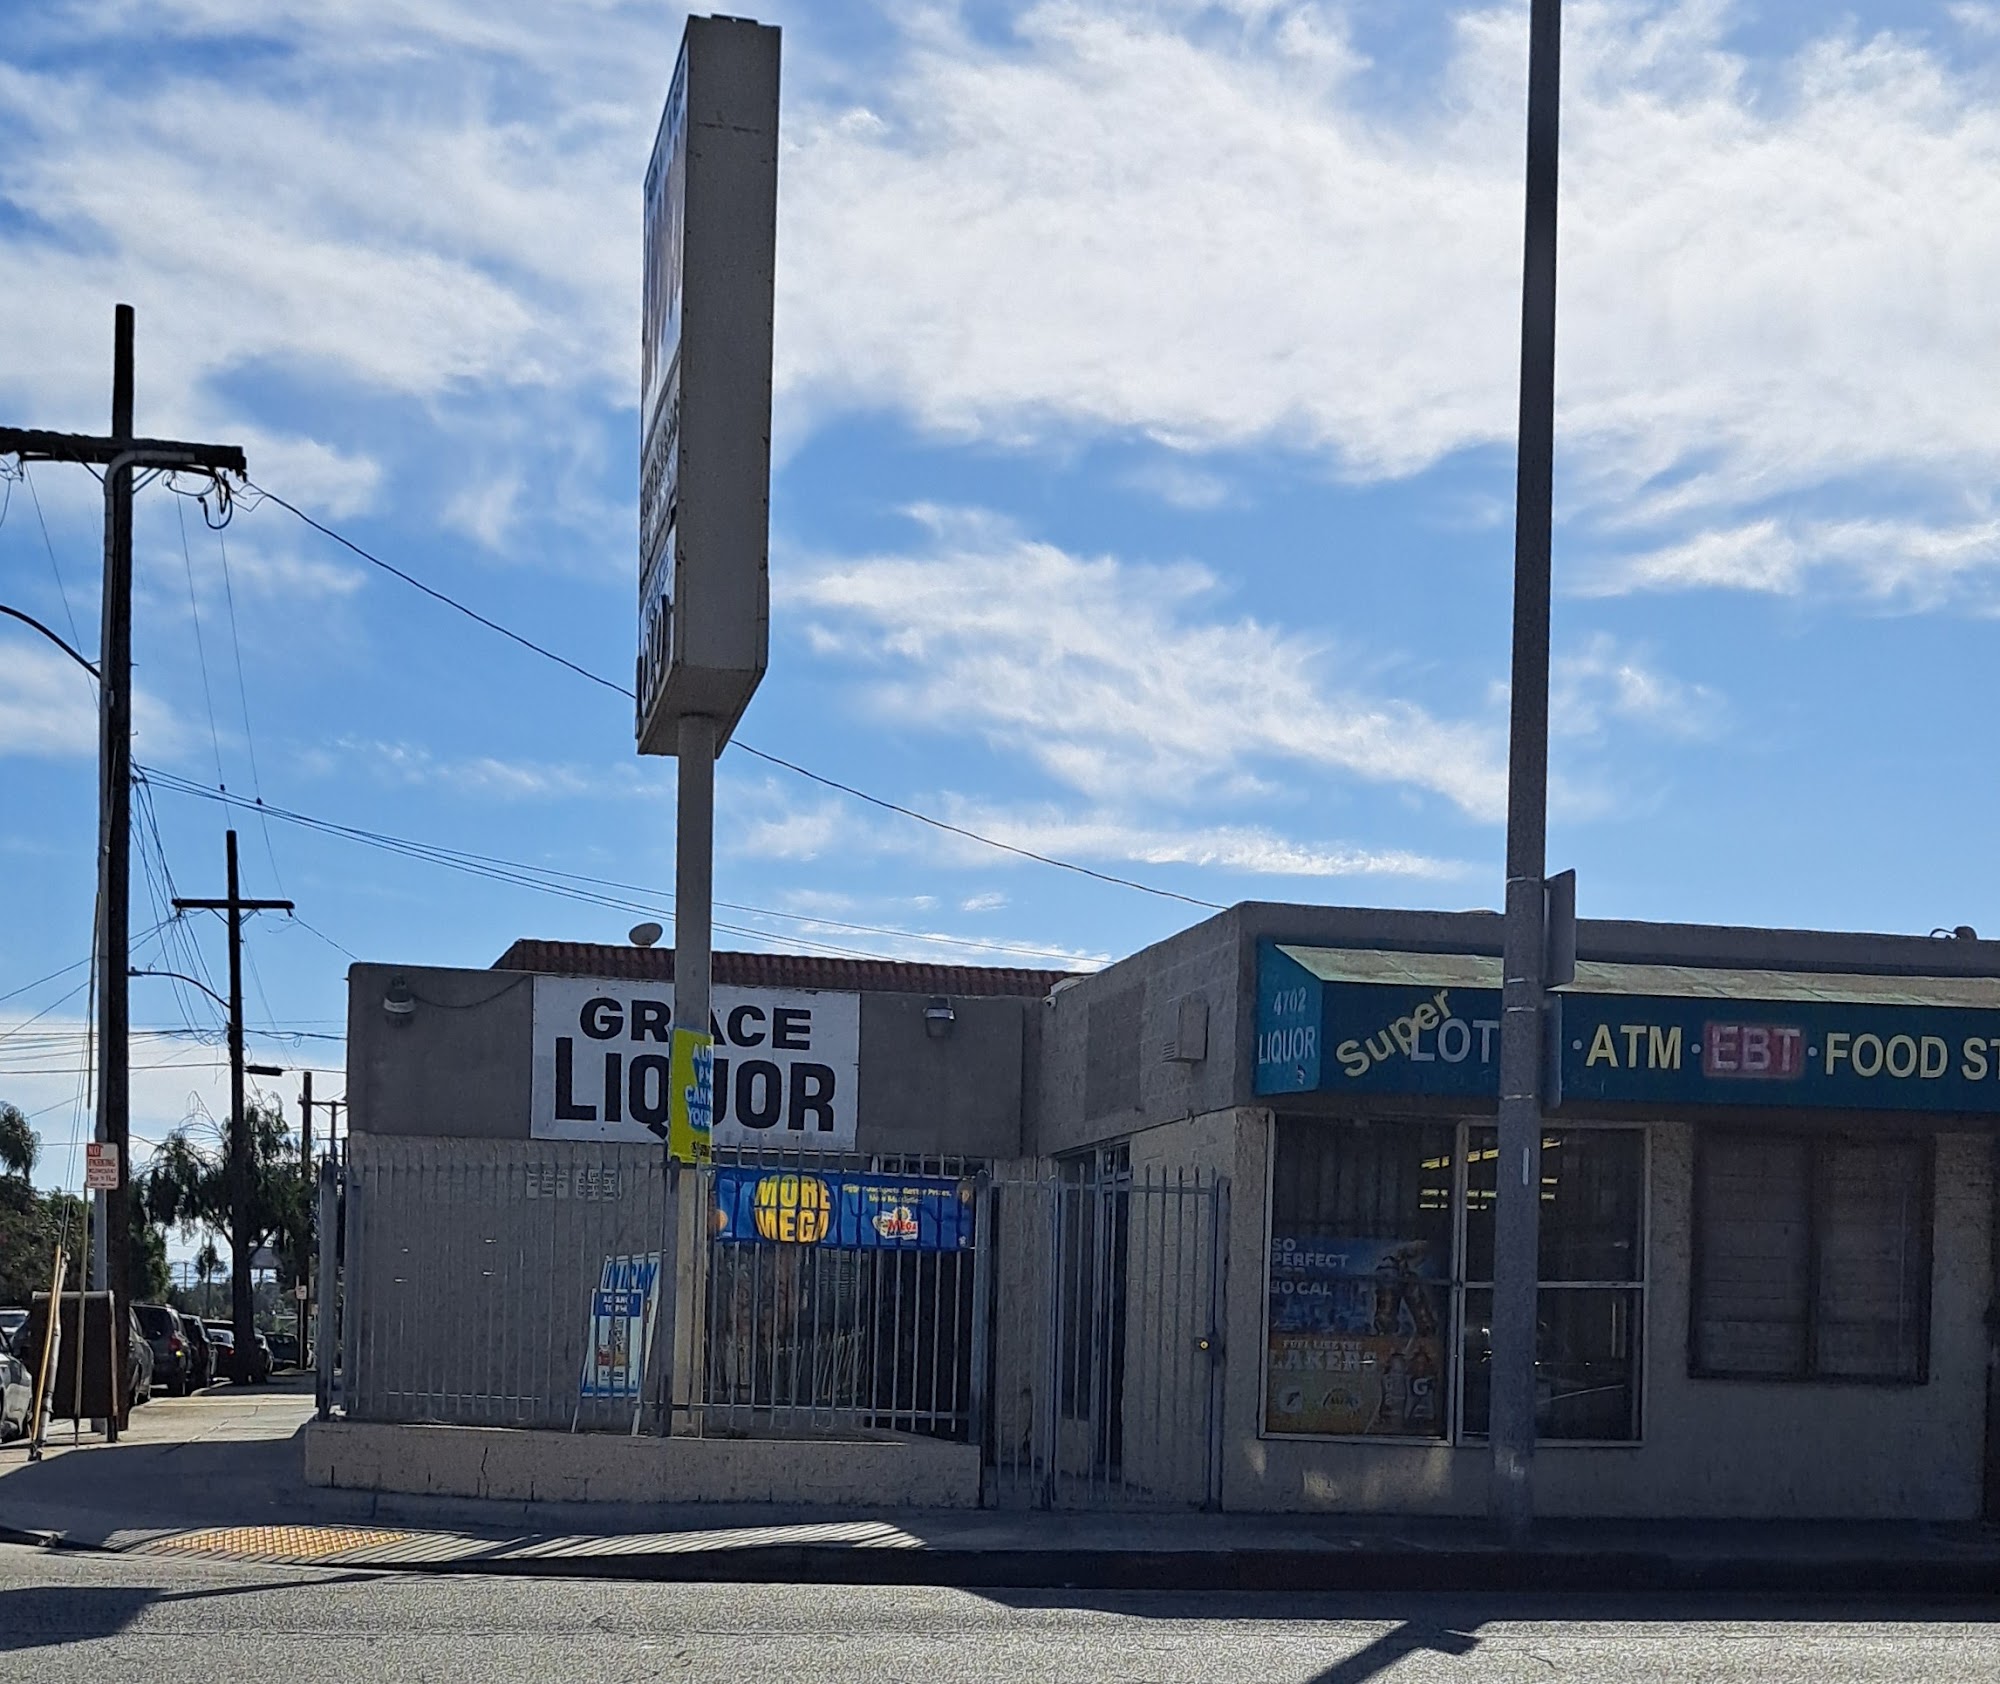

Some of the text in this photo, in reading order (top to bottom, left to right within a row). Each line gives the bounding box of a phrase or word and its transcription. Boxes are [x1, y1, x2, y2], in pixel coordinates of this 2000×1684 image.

[1258, 1025, 1316, 1065] LIQUOR
[1336, 989, 1452, 1077] Super
[1585, 1023, 1682, 1070] ATM
[1711, 1025, 1800, 1072] EBT
[1825, 1032, 1948, 1078] FOOD
[755, 1174, 831, 1209] MORE
[755, 1208, 829, 1243] MEGA
[1271, 1237, 1297, 1252] SO
[1271, 1251, 1350, 1268] PERFECT
